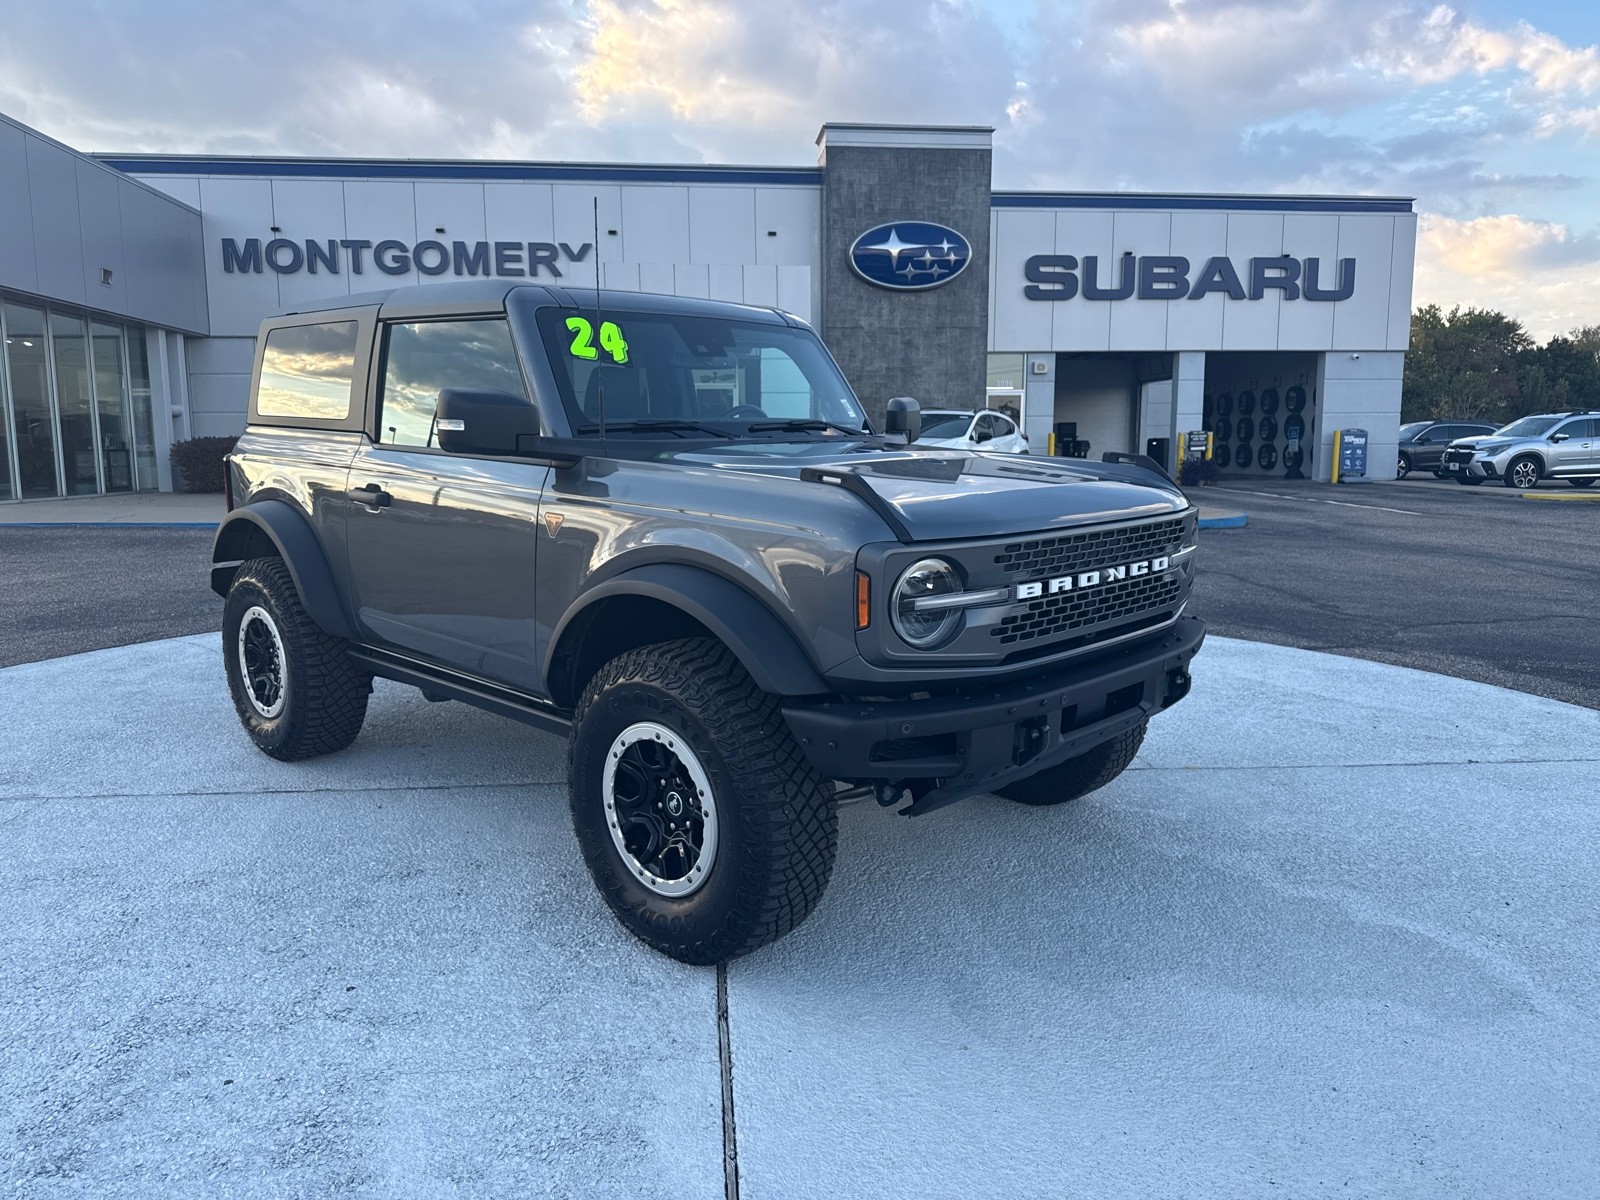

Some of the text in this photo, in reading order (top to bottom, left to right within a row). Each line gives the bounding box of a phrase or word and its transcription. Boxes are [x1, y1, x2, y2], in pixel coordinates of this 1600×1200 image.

[221, 237, 593, 277] MONTGOMERY
[1024, 254, 1357, 301] SUBARU
[565, 316, 629, 364] 24
[1016, 556, 1169, 600] BRONCO
